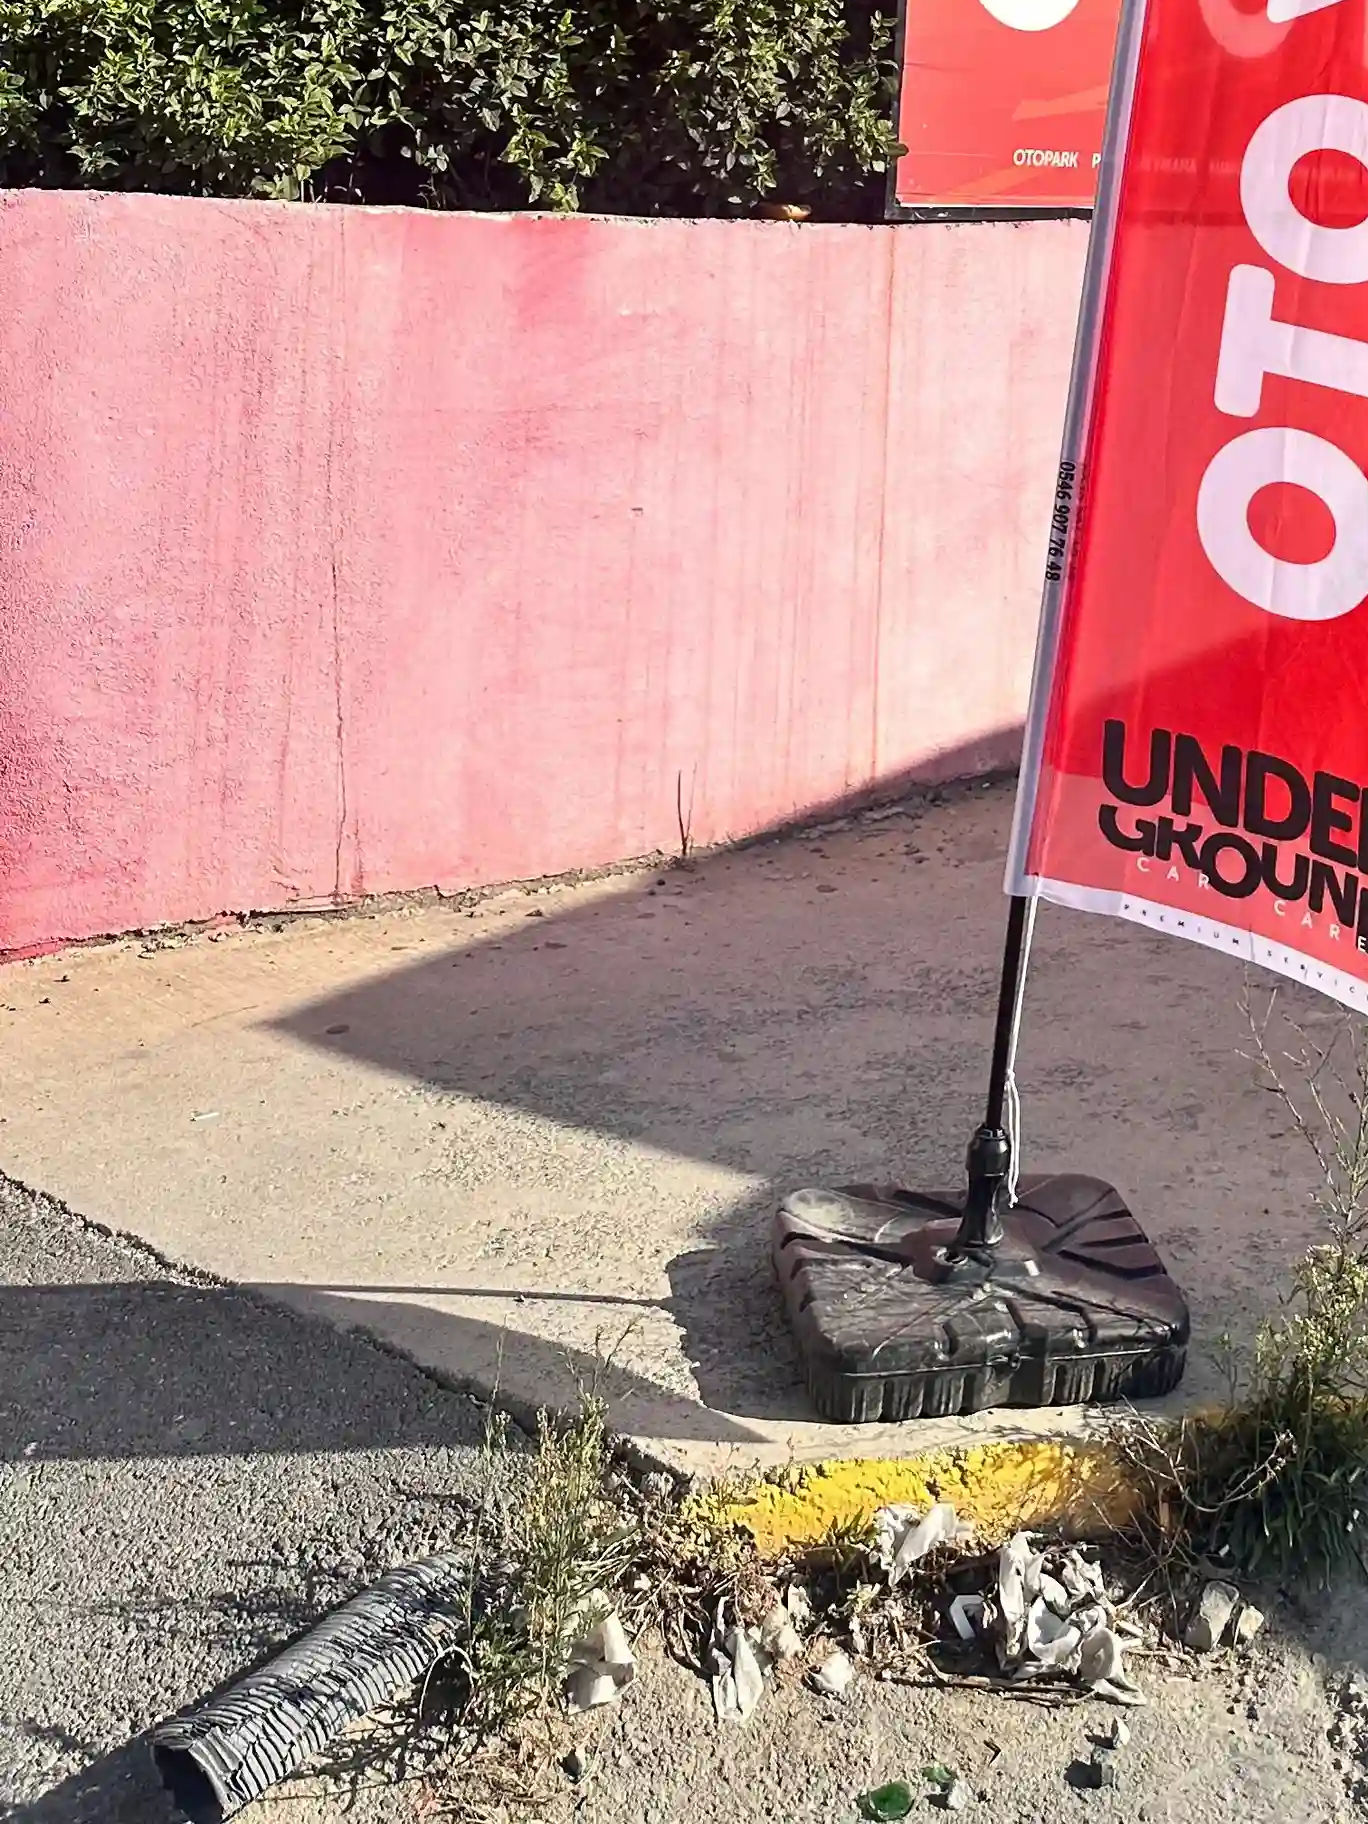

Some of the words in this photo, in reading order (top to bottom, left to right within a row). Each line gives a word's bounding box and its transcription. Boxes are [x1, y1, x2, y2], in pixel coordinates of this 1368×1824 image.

[1013, 148, 1079, 169] OTOPARK
[1056, 461, 1076, 500] 0546
[1051, 505, 1071, 534] 907
[1048, 538, 1066, 557] 76
[1045, 561, 1062, 582] 48
[1136, 856, 1211, 890] CAR
[1122, 903, 1240, 946] PREMIUM
